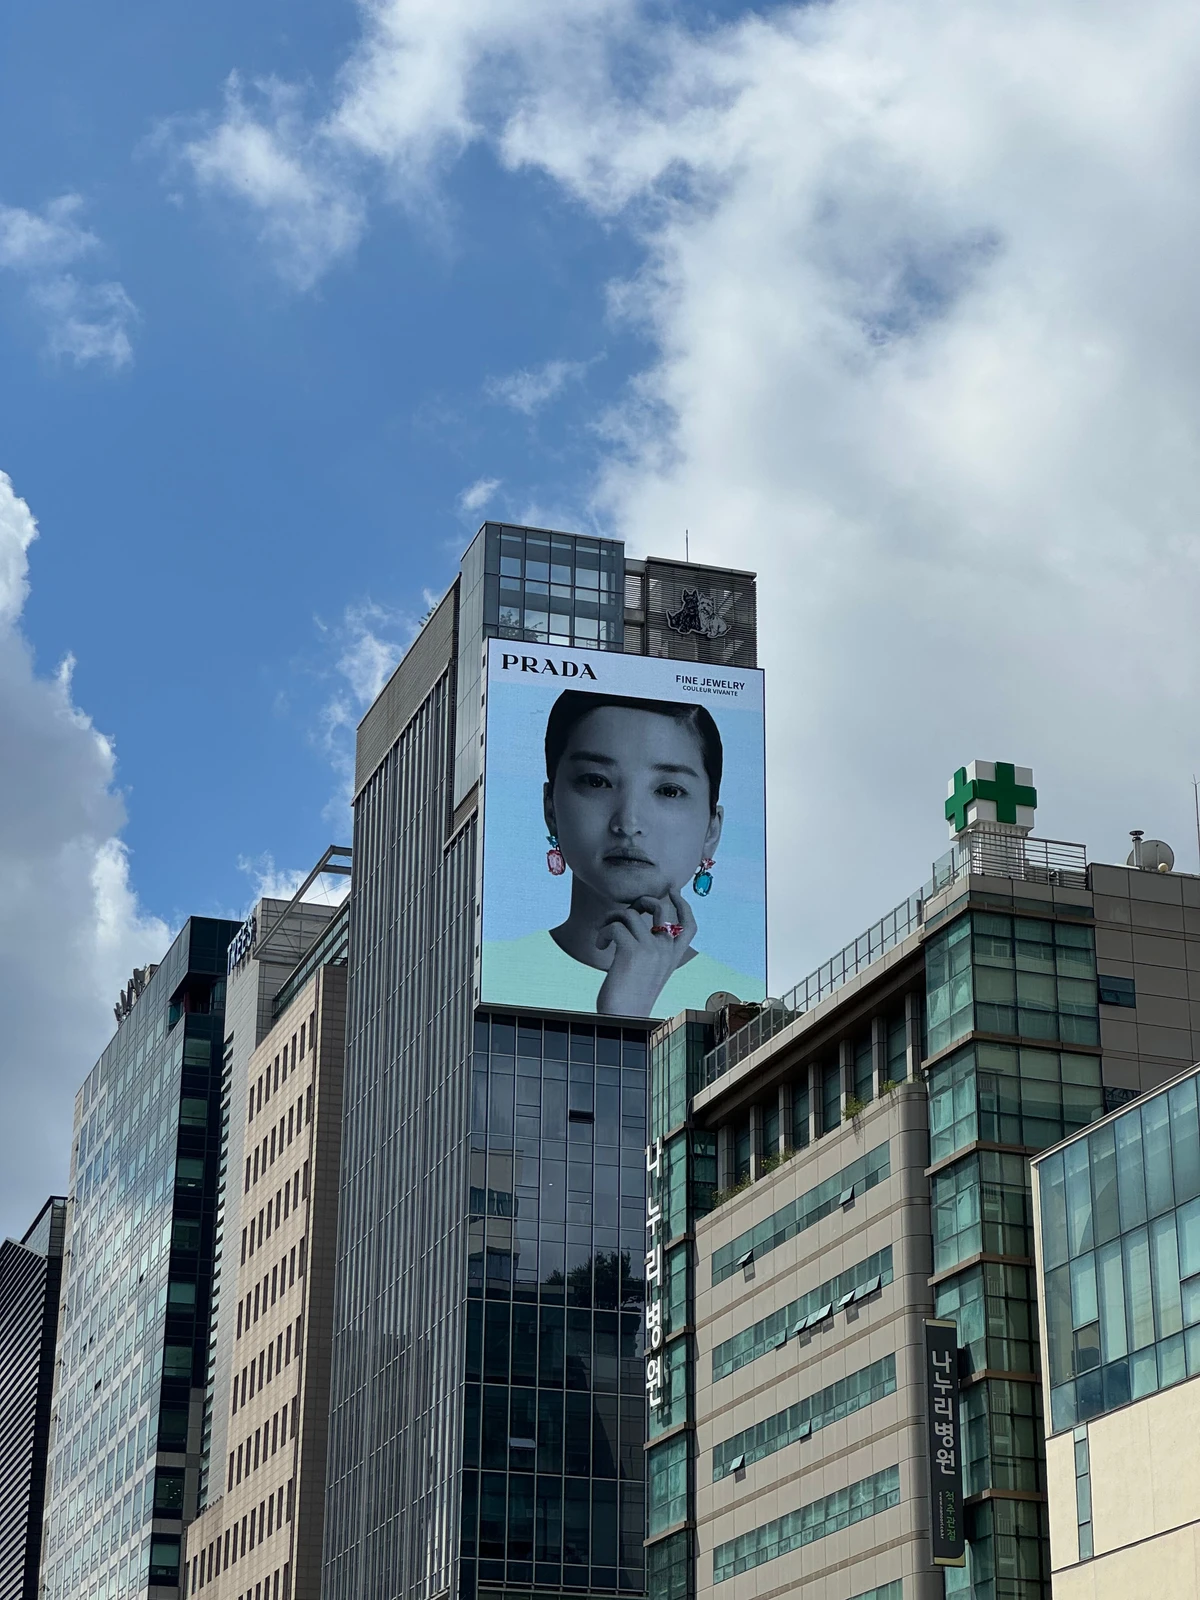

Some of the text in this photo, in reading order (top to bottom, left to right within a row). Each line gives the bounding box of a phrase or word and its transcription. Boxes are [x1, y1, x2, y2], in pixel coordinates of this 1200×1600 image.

[502, 653, 597, 680] PRADA
[675, 674, 746, 691] FINE JEWELRY
[682, 685, 738, 697] COULEUR VIVANTE
[646, 1137, 663, 1407] 나누리병원
[932, 1350, 955, 1475] 나누리병원
[945, 1490, 956, 1542] 척추관절
